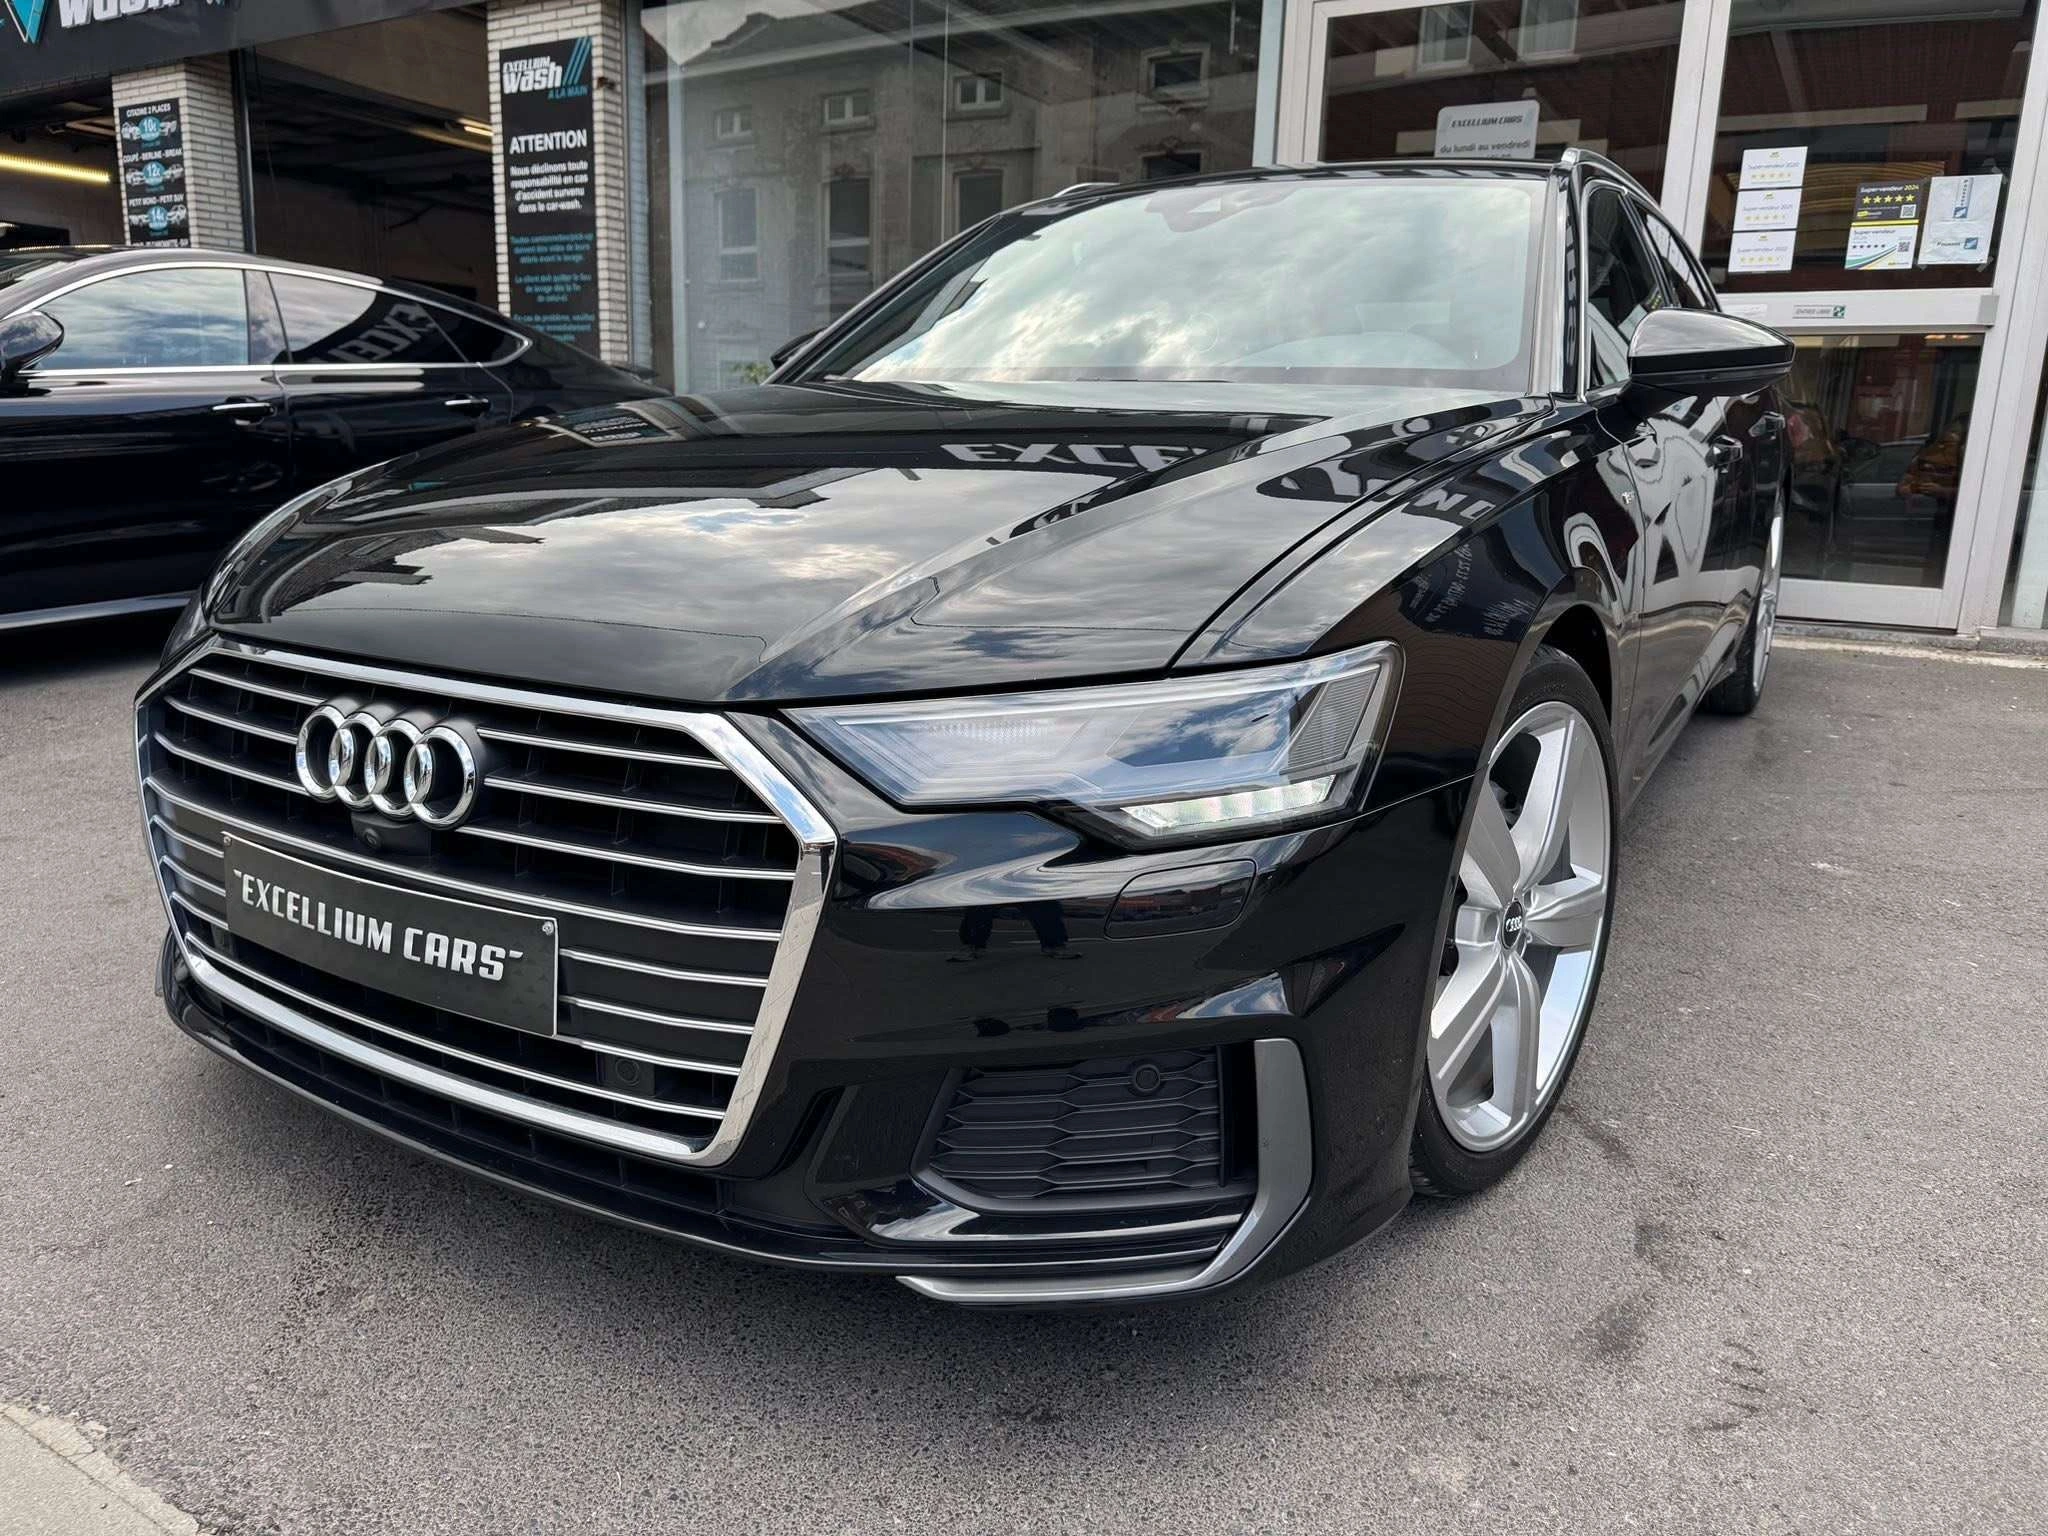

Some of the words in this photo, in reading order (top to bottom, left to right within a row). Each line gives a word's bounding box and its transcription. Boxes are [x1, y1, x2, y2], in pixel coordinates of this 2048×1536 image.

[503, 62, 563, 95] wash
[509, 129, 588, 155] ATTENTION
[510, 165, 530, 177] Nous
[567, 160, 588, 172] toute
[563, 175, 574, 185] en
[574, 173, 588, 183] cas
[554, 187, 585, 198] survenu
[518, 202, 537, 214] dans
[242, 872, 393, 955] EXCELLIUM
[403, 925, 507, 982] CARS
